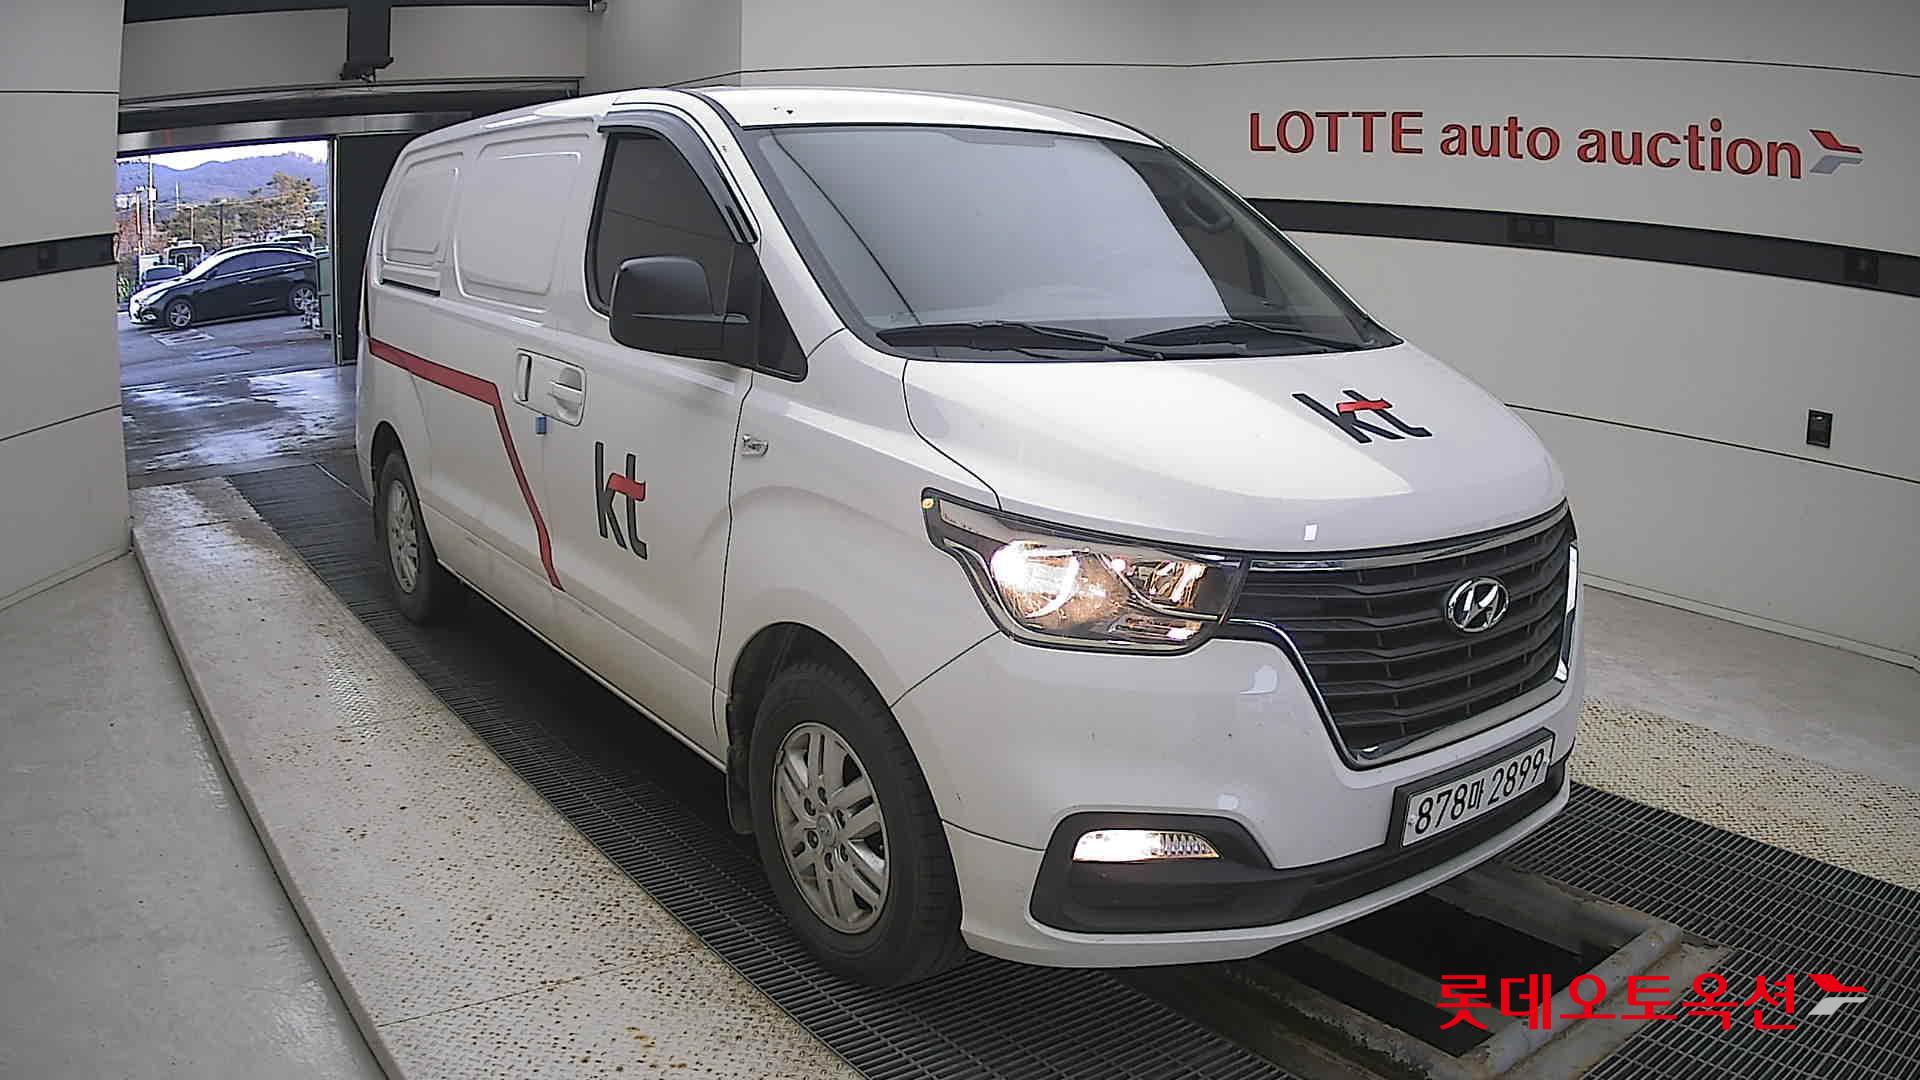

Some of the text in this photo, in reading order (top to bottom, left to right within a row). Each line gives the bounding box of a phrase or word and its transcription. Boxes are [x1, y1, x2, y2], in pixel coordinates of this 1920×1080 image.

[1249, 111, 1801, 179] LOTTE auto auction
[1292, 389, 1433, 444] kt
[595, 441, 648, 560] kt
[1415, 748, 1545, 834] 878마 2899
